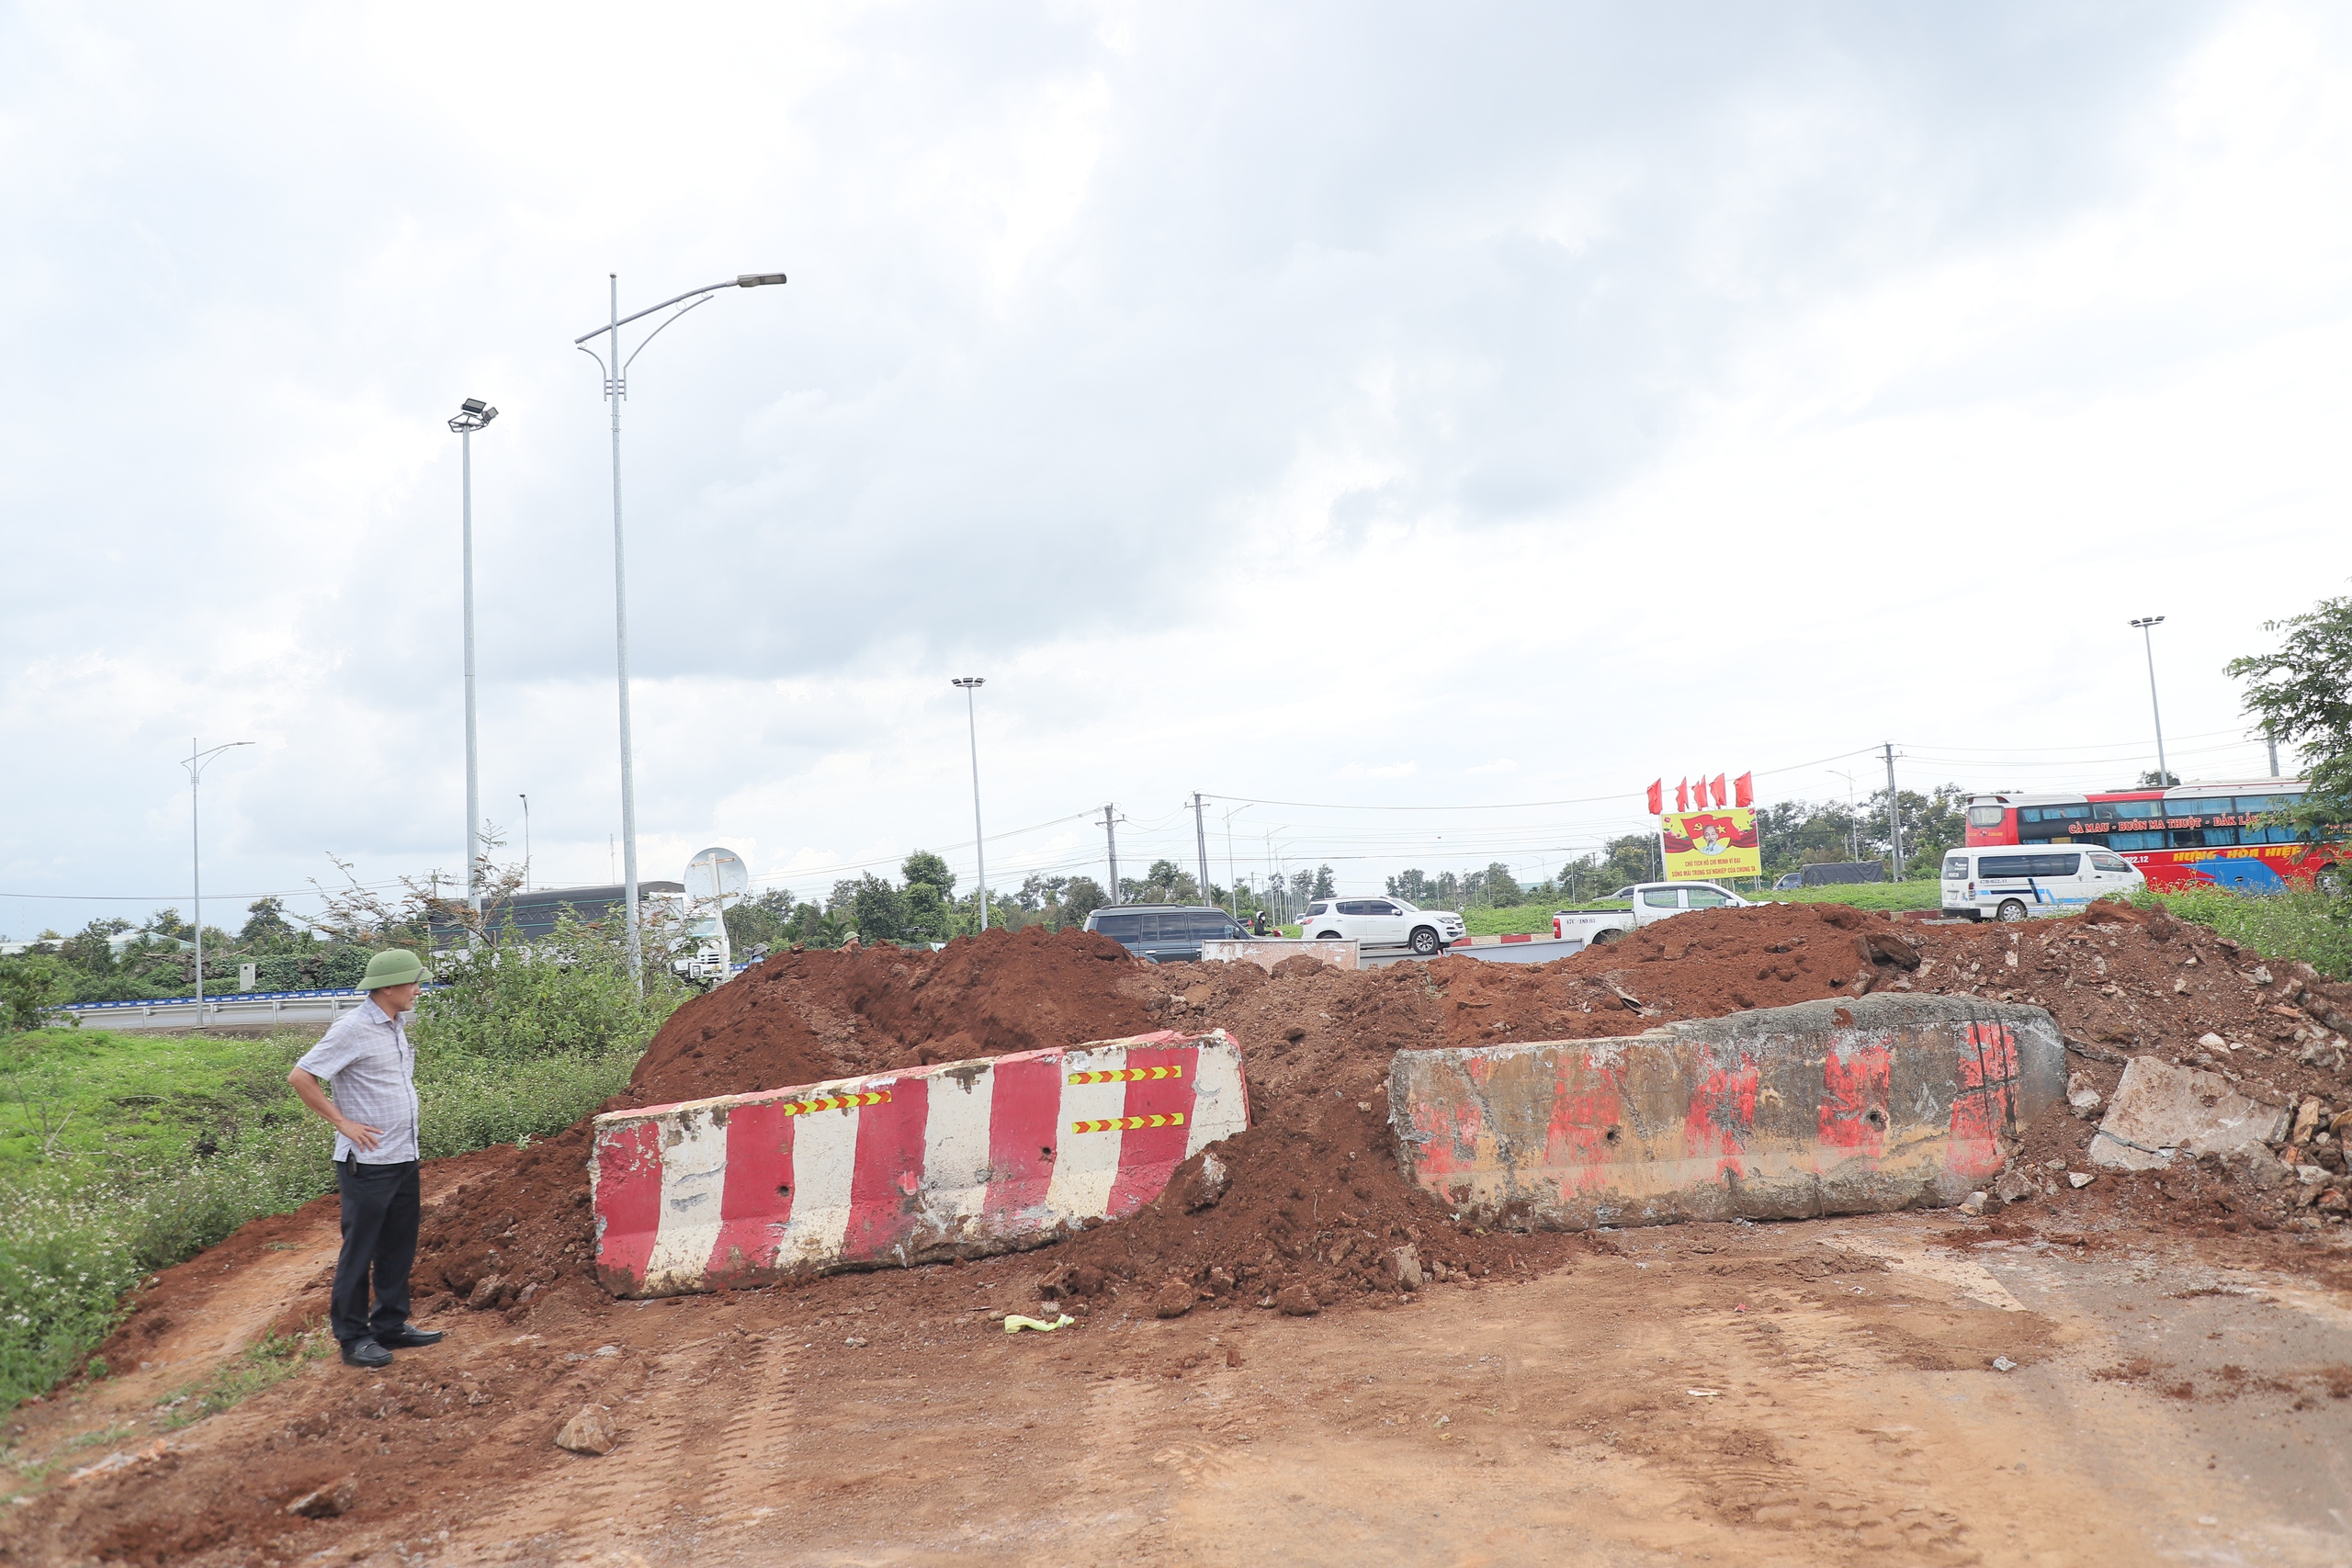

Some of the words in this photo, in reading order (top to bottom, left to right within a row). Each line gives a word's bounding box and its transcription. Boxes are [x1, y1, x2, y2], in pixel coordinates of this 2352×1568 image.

[2069, 820, 2084, 834] CÀ
[2086, 822, 2109, 833] MAU
[2118, 818, 2147, 831] BUÔN
[2149, 819, 2165, 829] MA
[2167, 816, 2201, 830] THUỘT
[2213, 812, 2236, 827] ĐẮK
[2173, 851, 2219, 862] HƯNG
[2226, 848, 2259, 859] HÒA
